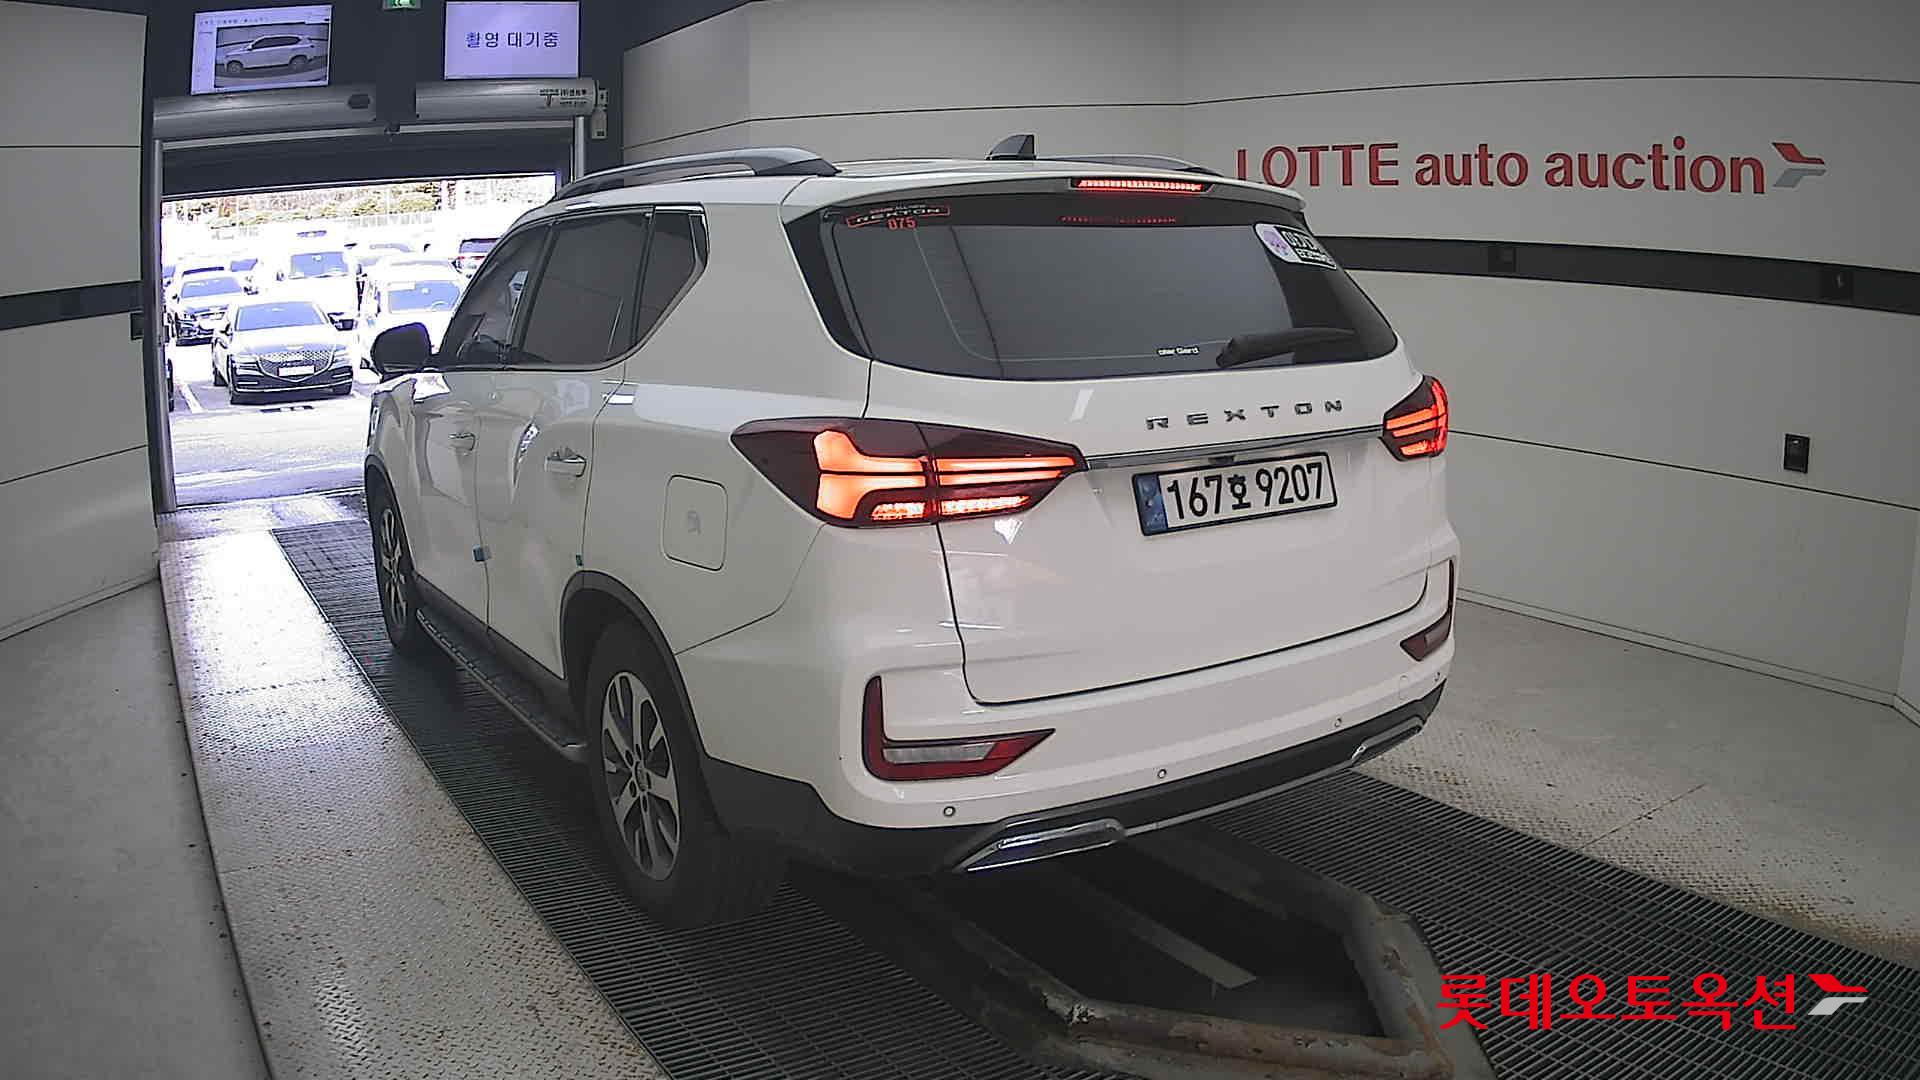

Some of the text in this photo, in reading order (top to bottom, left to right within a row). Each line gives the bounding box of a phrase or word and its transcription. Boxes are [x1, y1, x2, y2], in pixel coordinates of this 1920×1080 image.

[465, 32, 559, 48] 촬영 대기중
[1414, 143, 1529, 187] auto
[1544, 135, 1766, 194] auction
[1145, 400, 1343, 430] REXTON
[1167, 462, 1322, 520] 167호 9207
